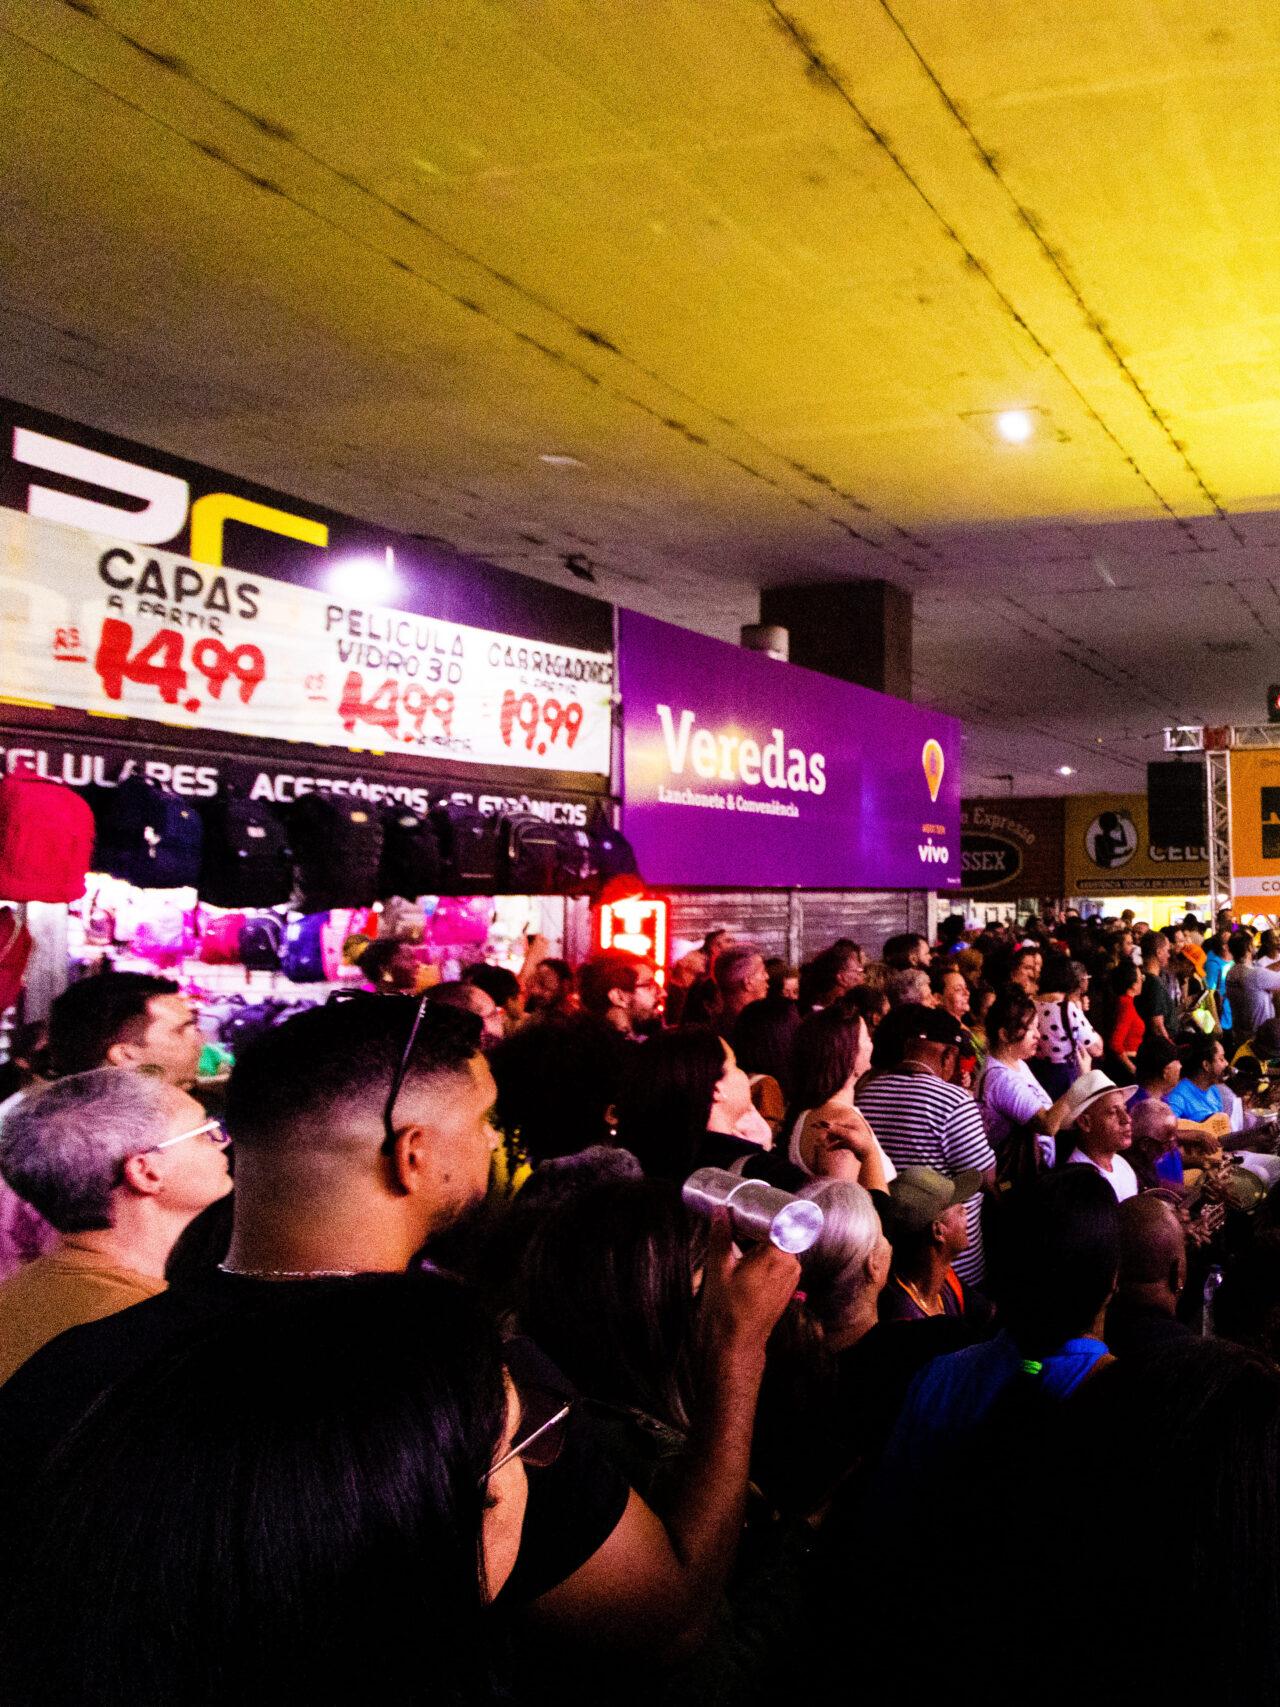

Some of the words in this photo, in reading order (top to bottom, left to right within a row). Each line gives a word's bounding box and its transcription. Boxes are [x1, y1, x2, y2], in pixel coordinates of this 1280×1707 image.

[98, 547, 260, 619] CAPAS
[107, 595, 123, 609] A
[138, 601, 224, 635] PARTIR
[325, 604, 464, 658] PELICULA
[94, 617, 266, 713] 14.99
[337, 638, 420, 677] VIDRO
[427, 657, 462, 684] 3D
[338, 670, 455, 743] 14.99
[0, 746, 218, 797] ELULRES
[656, 703, 826, 796] Veredas
[659, 785, 725, 809] Lanchonete
[726, 794, 735, 810] &
[736, 795, 799, 818] Conveniência
[918, 837, 949, 864] vivo
